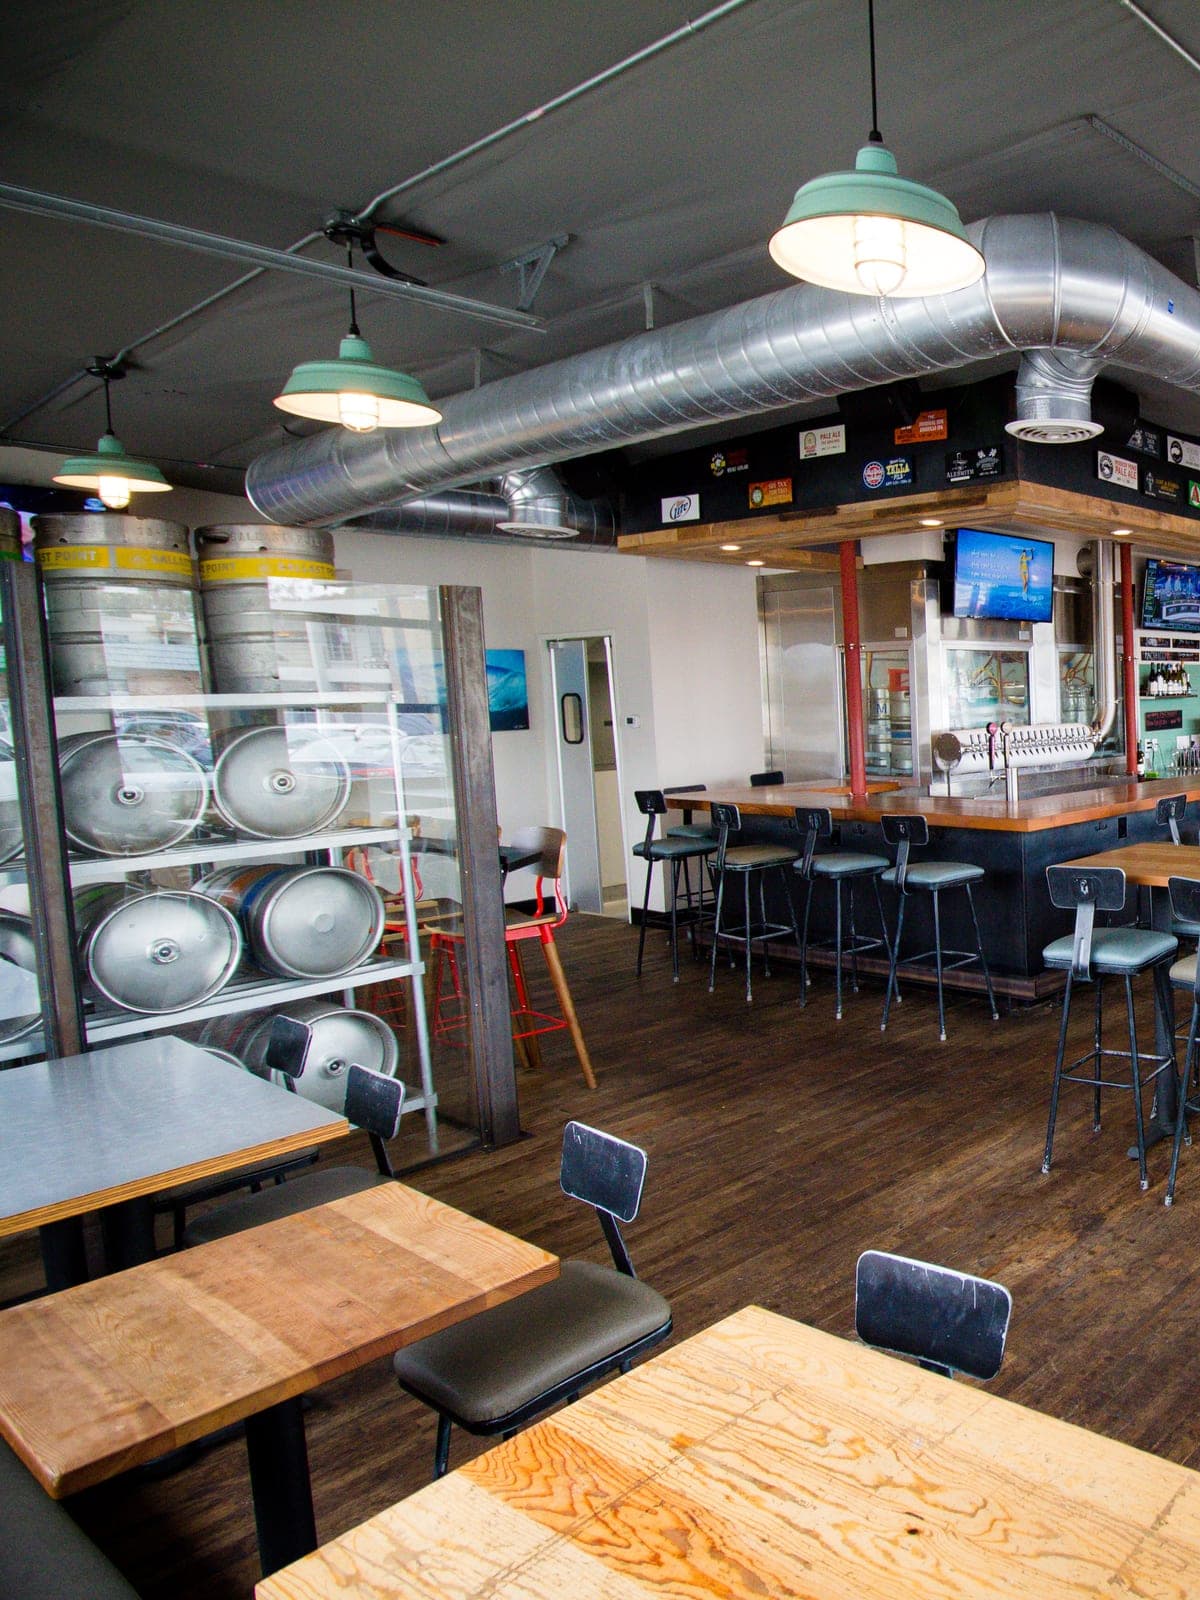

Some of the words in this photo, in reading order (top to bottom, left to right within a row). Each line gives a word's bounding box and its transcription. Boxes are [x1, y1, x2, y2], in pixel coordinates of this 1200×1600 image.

[947, 469, 974, 478] ALESMITH
[1115, 465, 1127, 477] PALE
[1127, 470, 1137, 480] ALE
[55, 551, 97, 561] POINT
